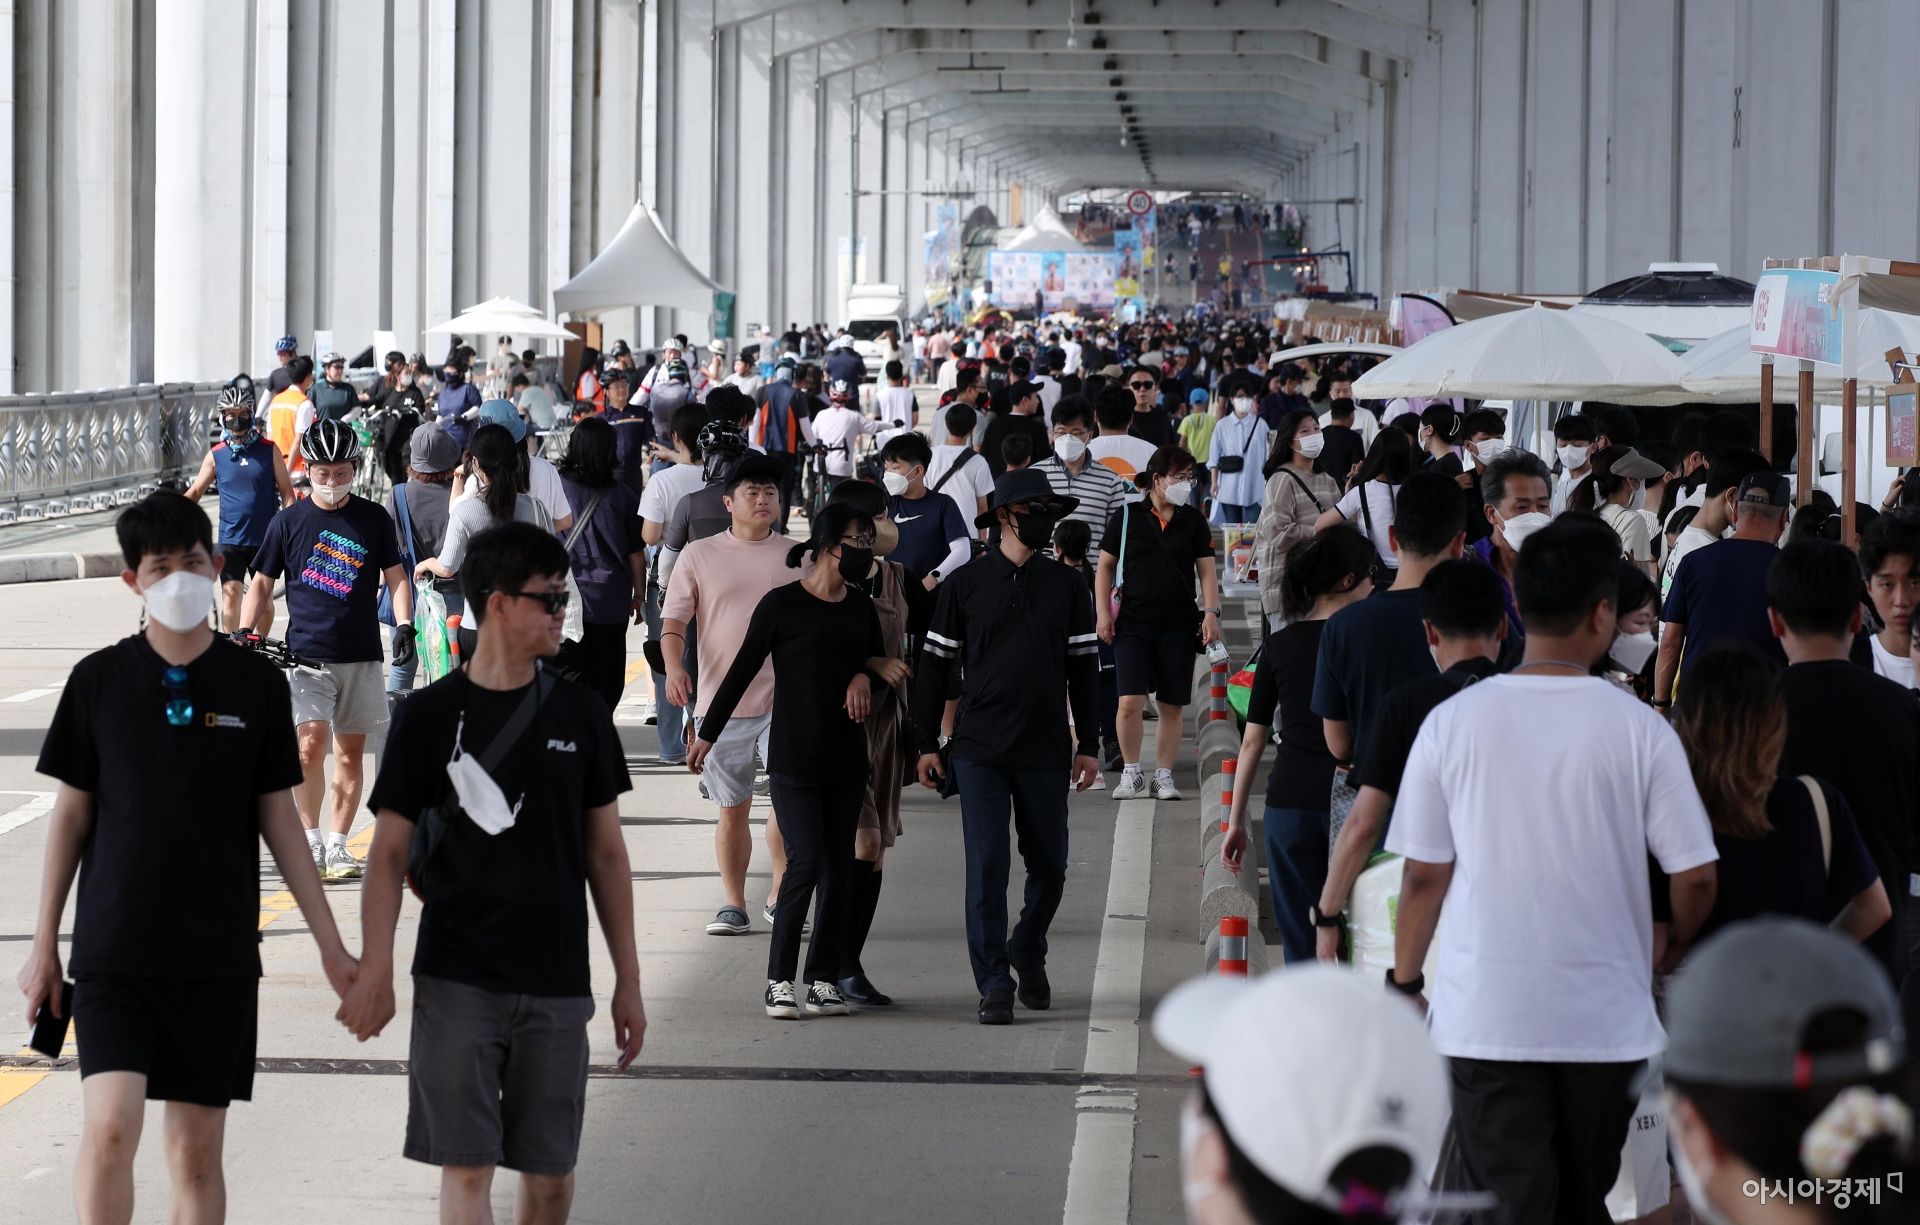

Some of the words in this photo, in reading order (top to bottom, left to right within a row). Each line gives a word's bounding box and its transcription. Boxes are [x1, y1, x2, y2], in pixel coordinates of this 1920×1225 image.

[1133, 196, 1146, 208] 40
[319, 530, 369, 555] KINGDOM
[307, 555, 359, 581] KINGDOM
[313, 543, 365, 569] KINGDOM
[302, 568, 353, 593] KINGDOM
[302, 574, 348, 602] PIONEER
[547, 740, 577, 752] FILA
